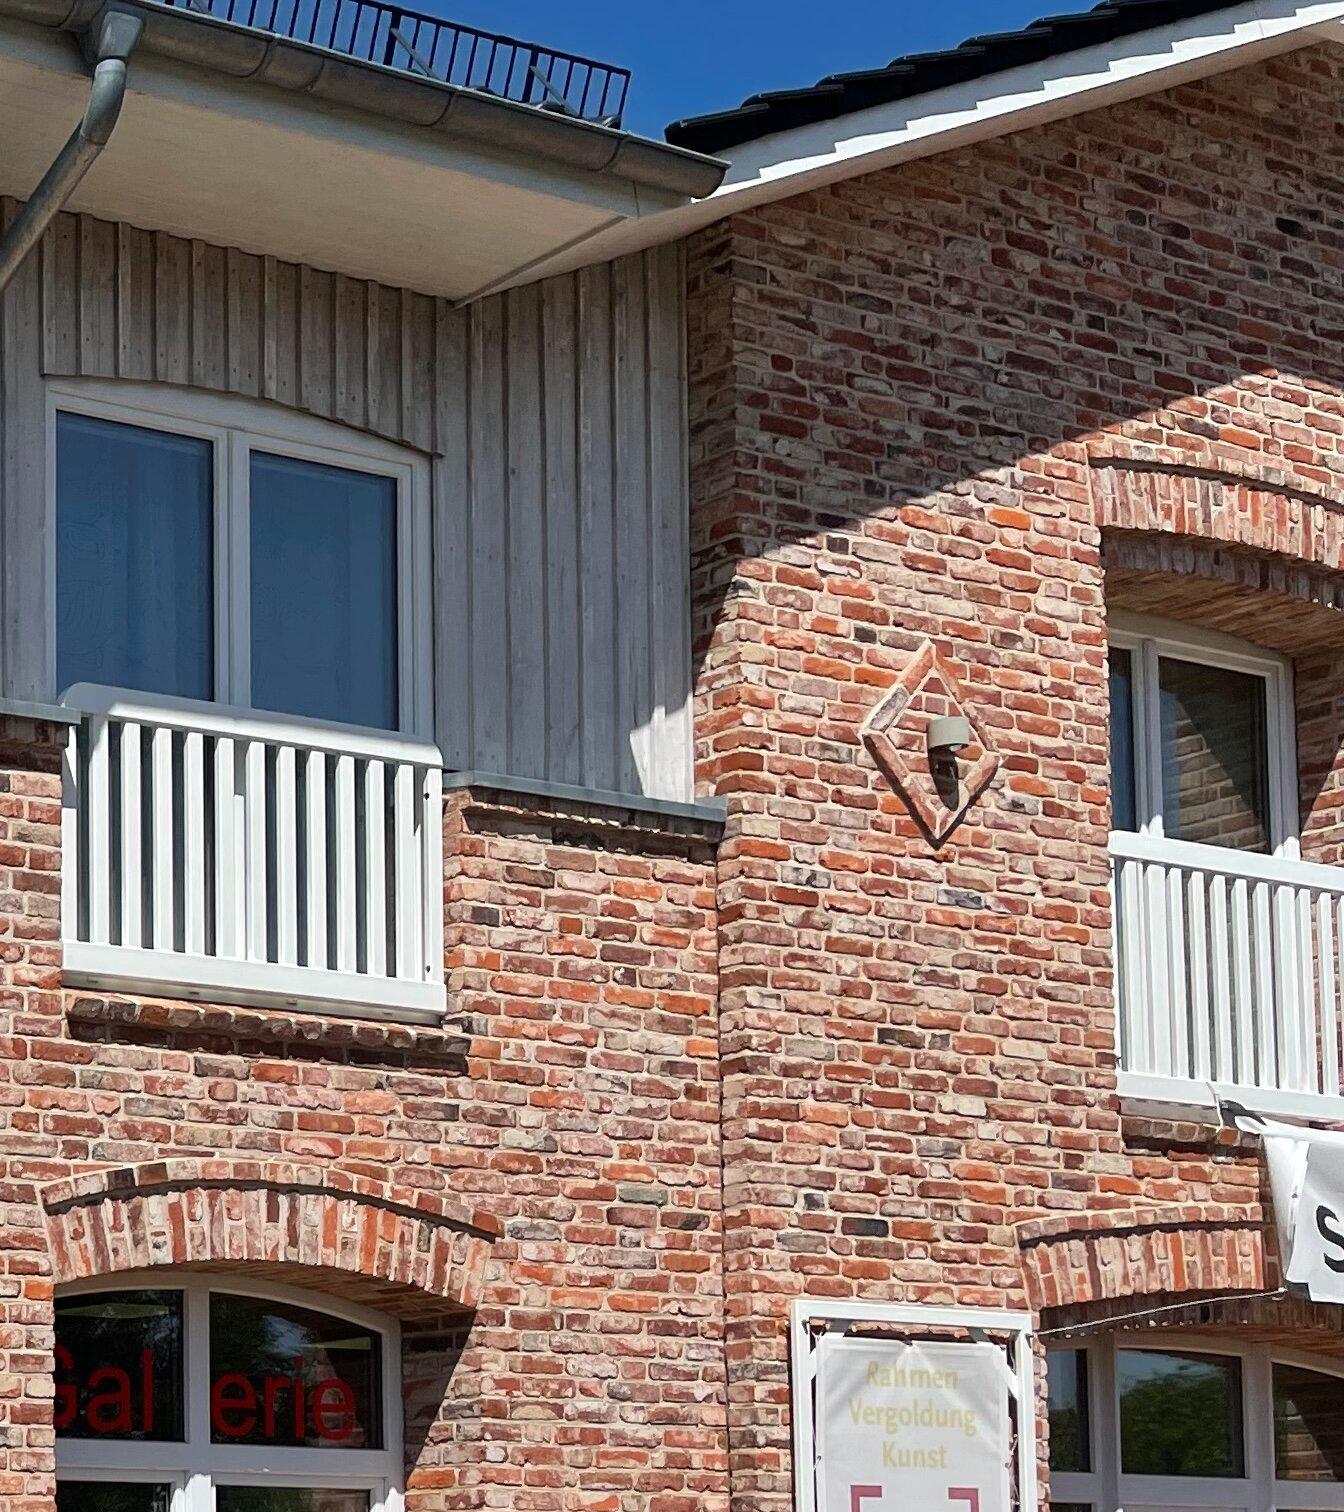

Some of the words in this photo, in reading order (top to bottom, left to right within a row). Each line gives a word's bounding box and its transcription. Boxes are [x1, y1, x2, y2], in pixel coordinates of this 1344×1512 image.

[867, 1360, 959, 1389] Rahmen
[849, 1399, 978, 1437] Vergoldung
[883, 1441, 949, 1469] Kunst
